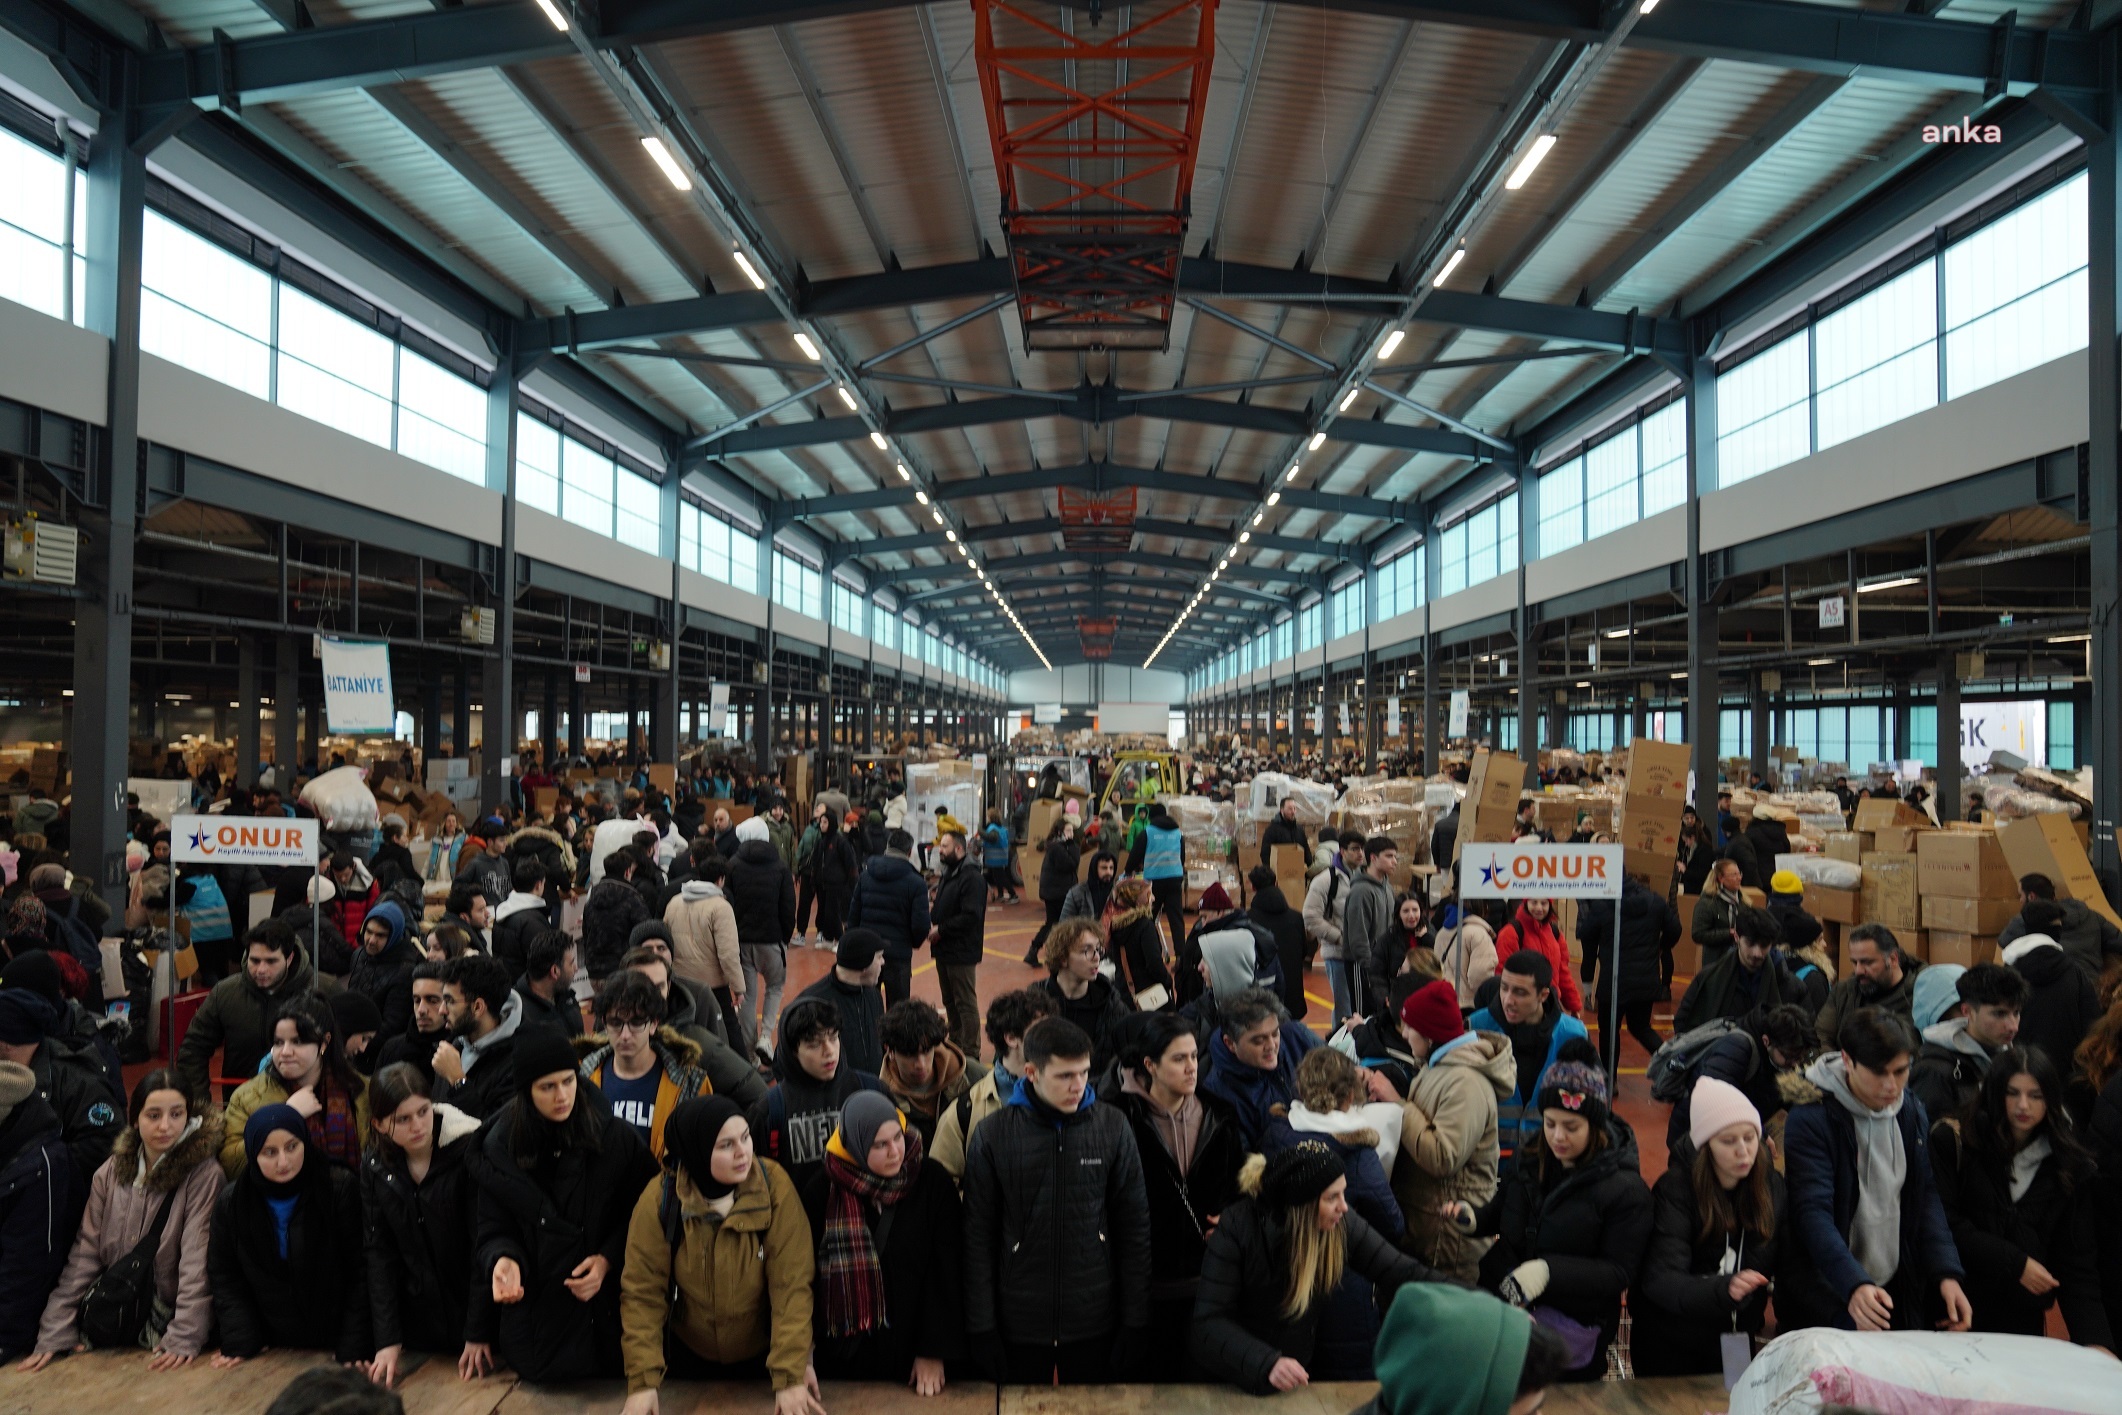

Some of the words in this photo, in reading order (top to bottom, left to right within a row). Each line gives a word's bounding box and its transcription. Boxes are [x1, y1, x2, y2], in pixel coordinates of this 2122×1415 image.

[1824, 601, 1838, 617] A5
[327, 673, 384, 693] BATTANİYE
[217, 826, 303, 848] ONUR
[1512, 855, 1606, 879] ONUR
